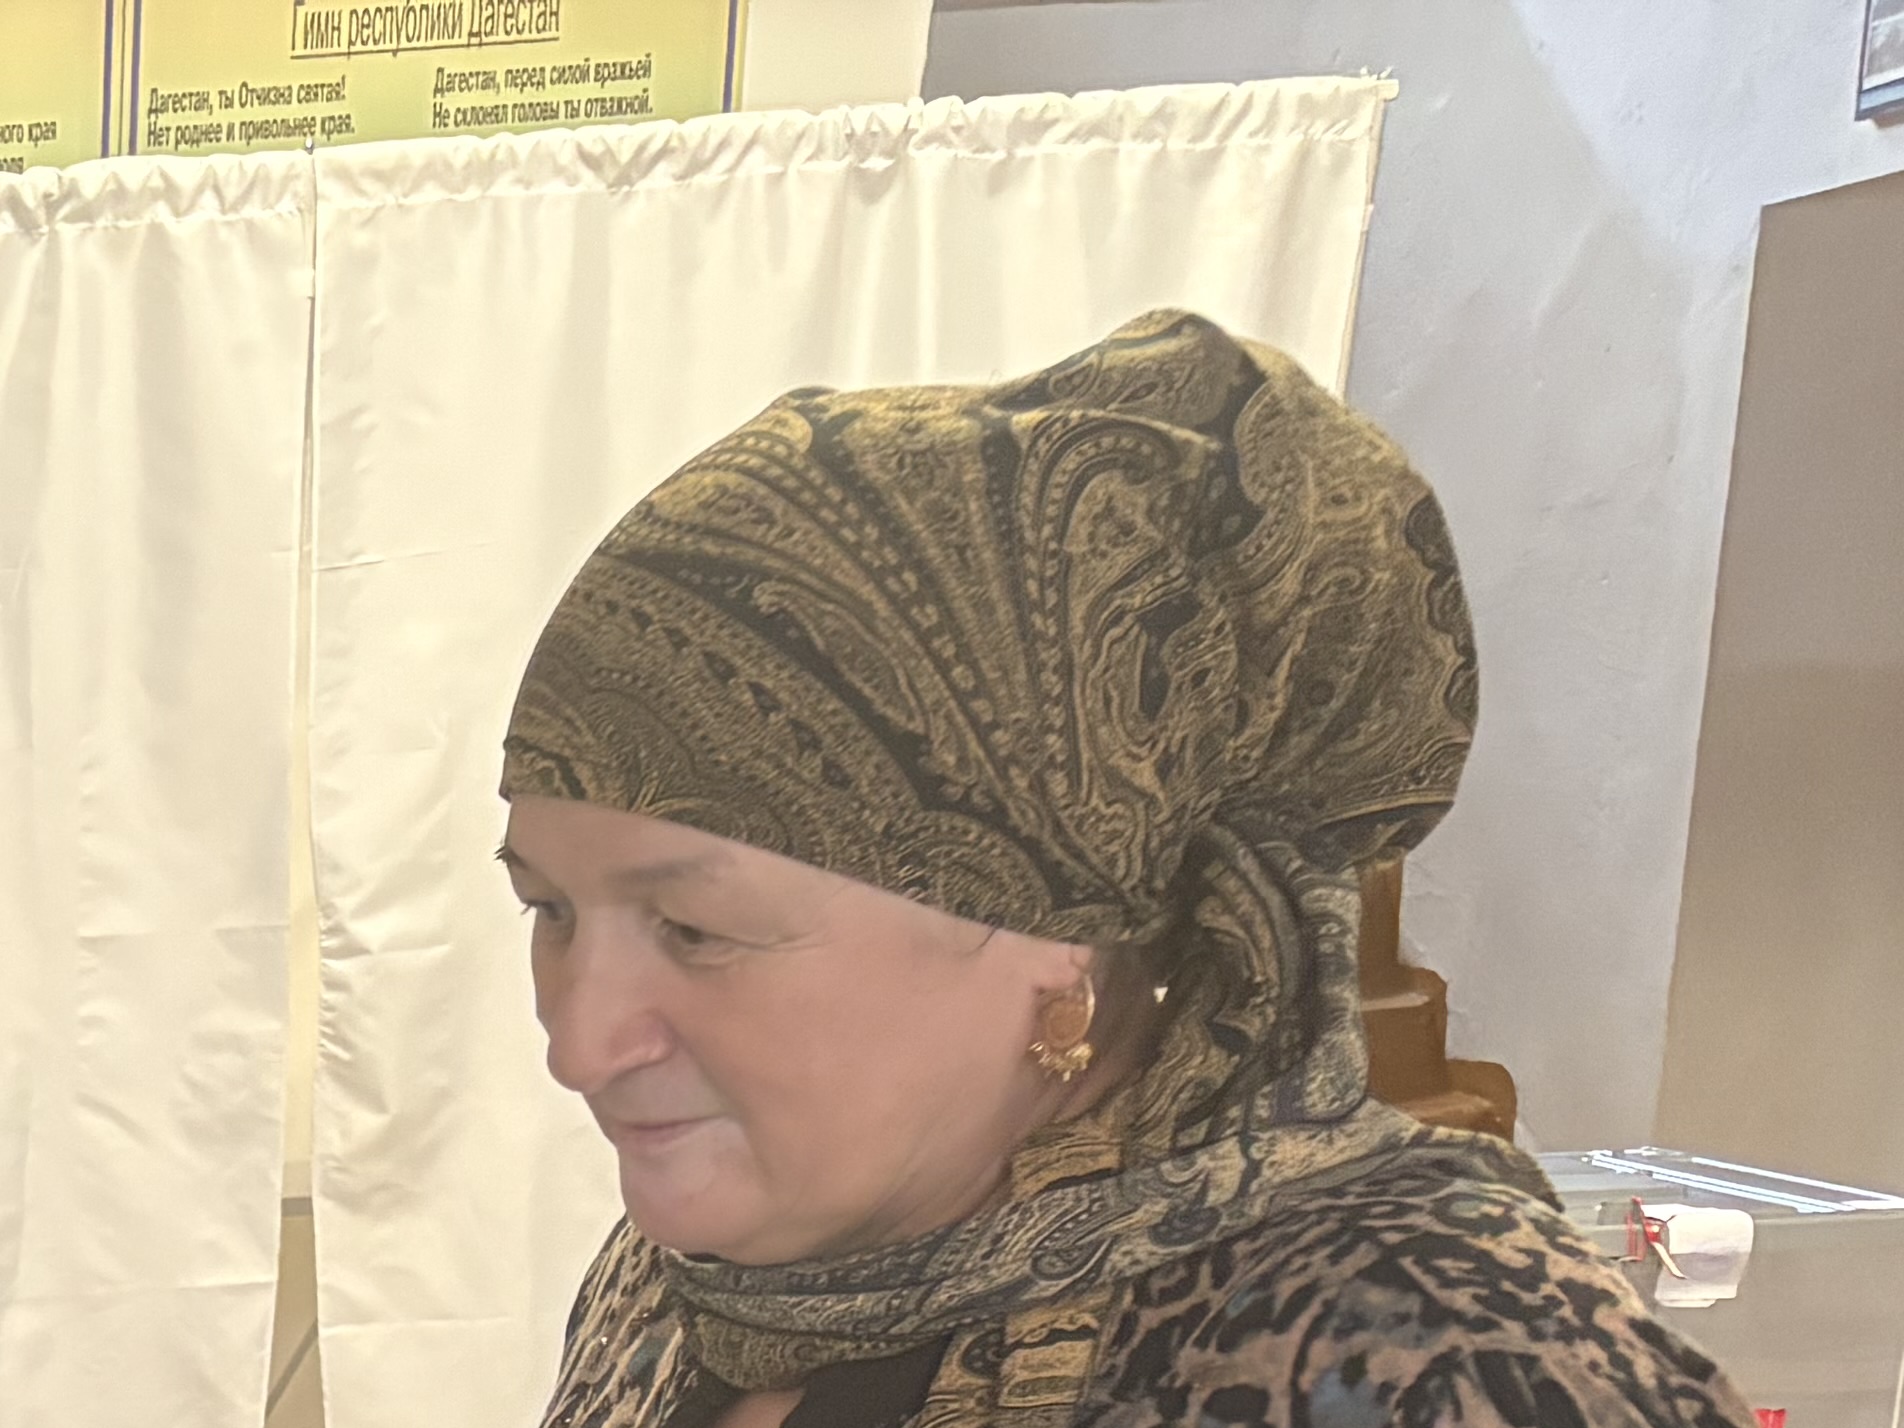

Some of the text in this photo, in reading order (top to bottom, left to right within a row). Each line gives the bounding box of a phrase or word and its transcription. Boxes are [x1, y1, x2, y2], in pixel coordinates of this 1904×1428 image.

[148, 74, 345, 119] Дагестан, ты Отчизна святая!
[433, 53, 652, 99] Дагестан, перед силой вражьей
[433, 102, 450, 129] Не
[511, 101, 560, 123] головы
[563, 99, 580, 119] ты
[584, 88, 653, 116] отважной.
[28, 122, 57, 148] края
[147, 113, 355, 151] Нет роднее и привольнее края.
